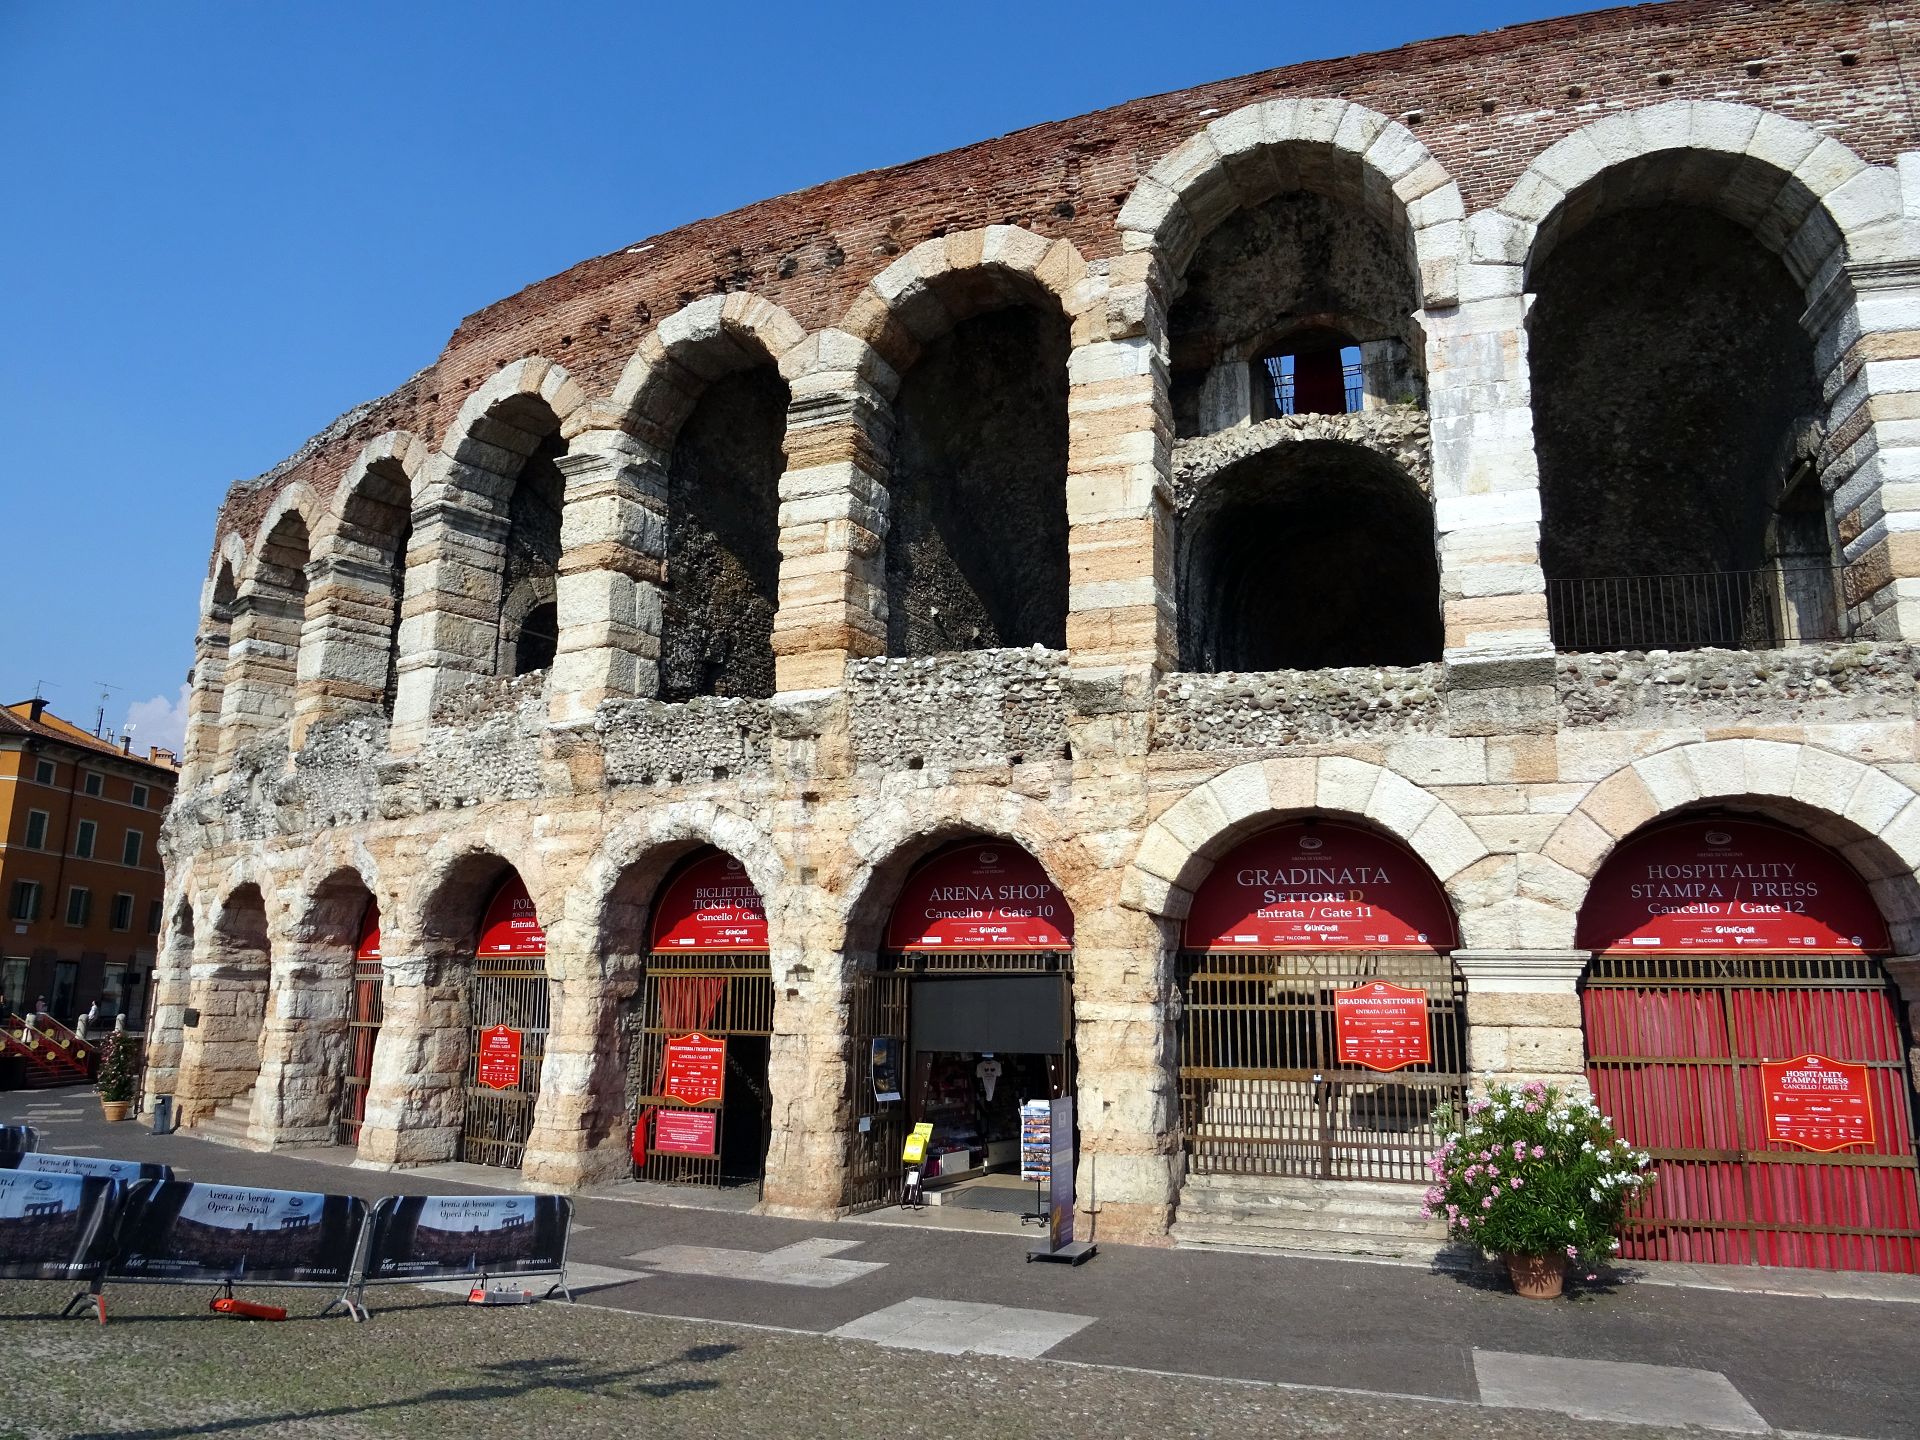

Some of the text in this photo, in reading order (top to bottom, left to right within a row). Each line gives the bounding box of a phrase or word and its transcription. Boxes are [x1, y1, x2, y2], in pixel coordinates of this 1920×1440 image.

[1237, 867, 1391, 886] GRADINATA
[1647, 863, 1797, 879] HOSPITALITY
[929, 884, 1051, 901] ARENA SHOP
[1263, 889, 1364, 903] SETTORE D
[1631, 881, 1818, 900] STAMPA / PRESS
[693, 898, 732, 910] TICKET
[1647, 900, 1806, 915] Cancello / Gate 12
[696, 911, 762, 921] Cancello / Gate
[925, 904, 1054, 920] Cancello / Gate 10
[1256, 906, 1373, 919] Entrata / Gate 11
[511, 920, 535, 928] Entrata
[1311, 924, 1338, 932] UniCredit
[1723, 926, 1755, 934] UniCredit
[1785, 1070, 1842, 1078] HOSPITALITY
[1823, 1077, 1848, 1085] PRESS
[38, 1158, 60, 1167] Arena
[62, 1159, 70, 1167] di
[207, 1190, 275, 1203] Arena di Verona
[207, 1203, 234, 1212] Opera
[236, 1203, 269, 1215] Festival
[438, 1199, 460, 1208] Arena
[472, 1200, 495, 1208] Verona
[439, 1209, 490, 1220] Opera Festival
[294, 1267, 338, 1275] www.arena.it
